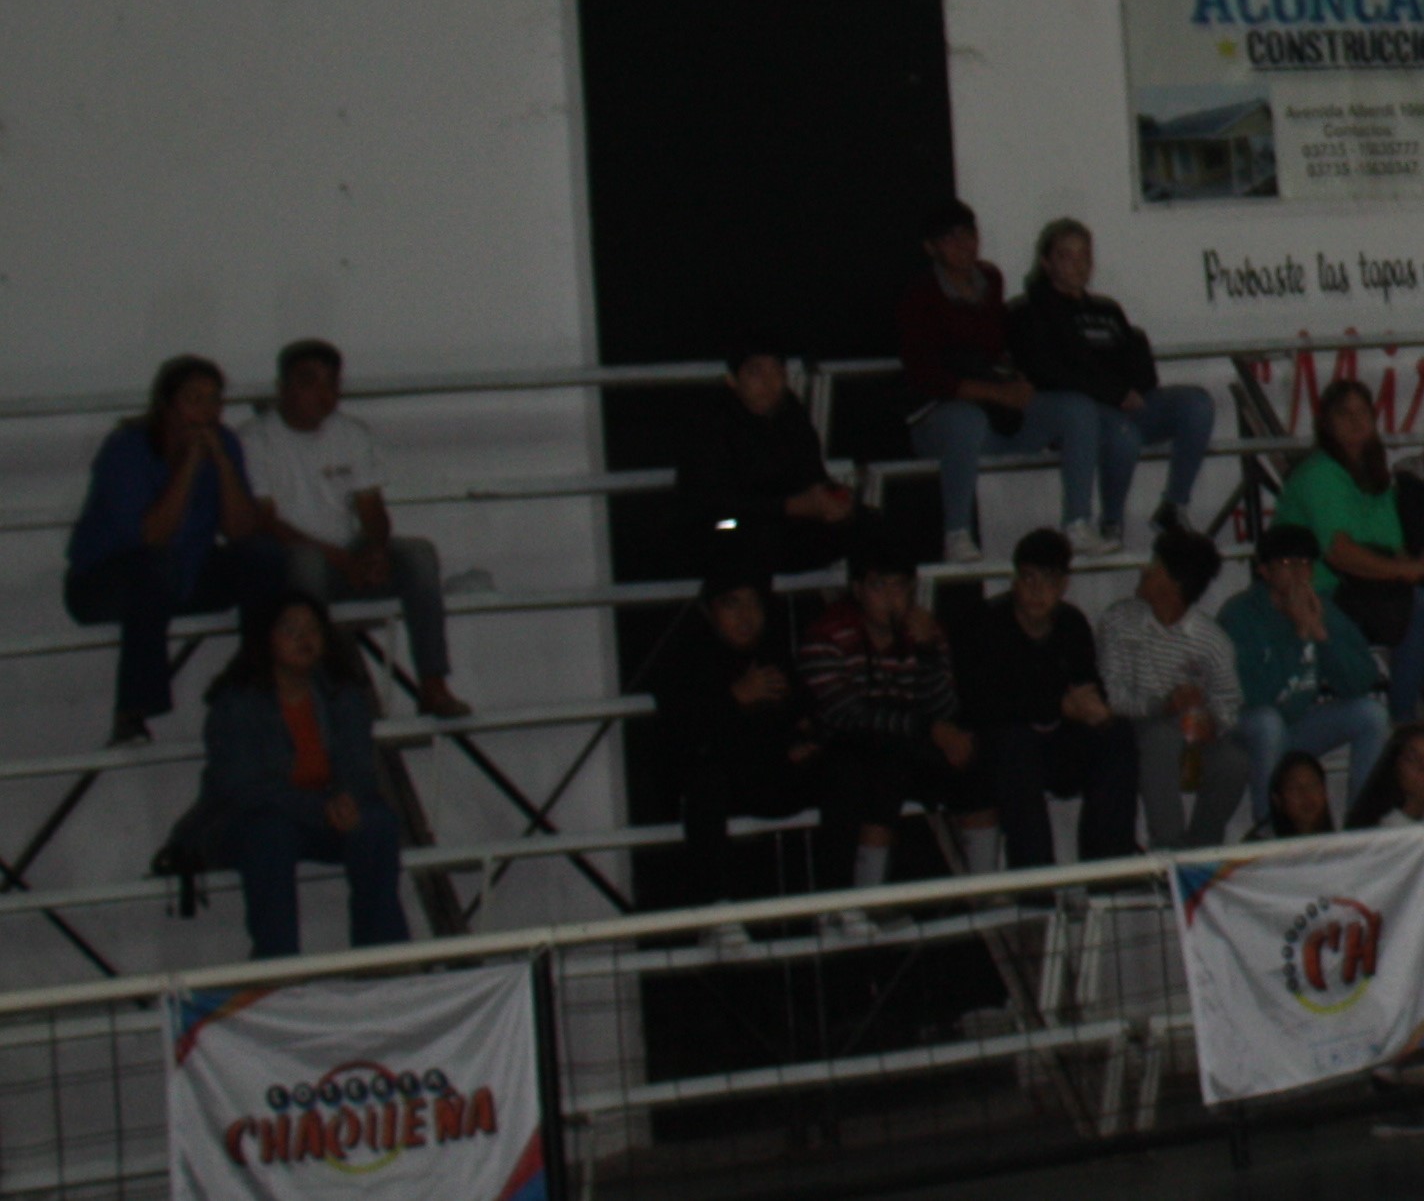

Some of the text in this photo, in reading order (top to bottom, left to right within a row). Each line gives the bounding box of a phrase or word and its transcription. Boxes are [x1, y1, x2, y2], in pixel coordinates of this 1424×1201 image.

[1203, 248, 1305, 307] Probaste
[1317, 251, 1350, 296] las
[1358, 250, 1418, 304] tapas
